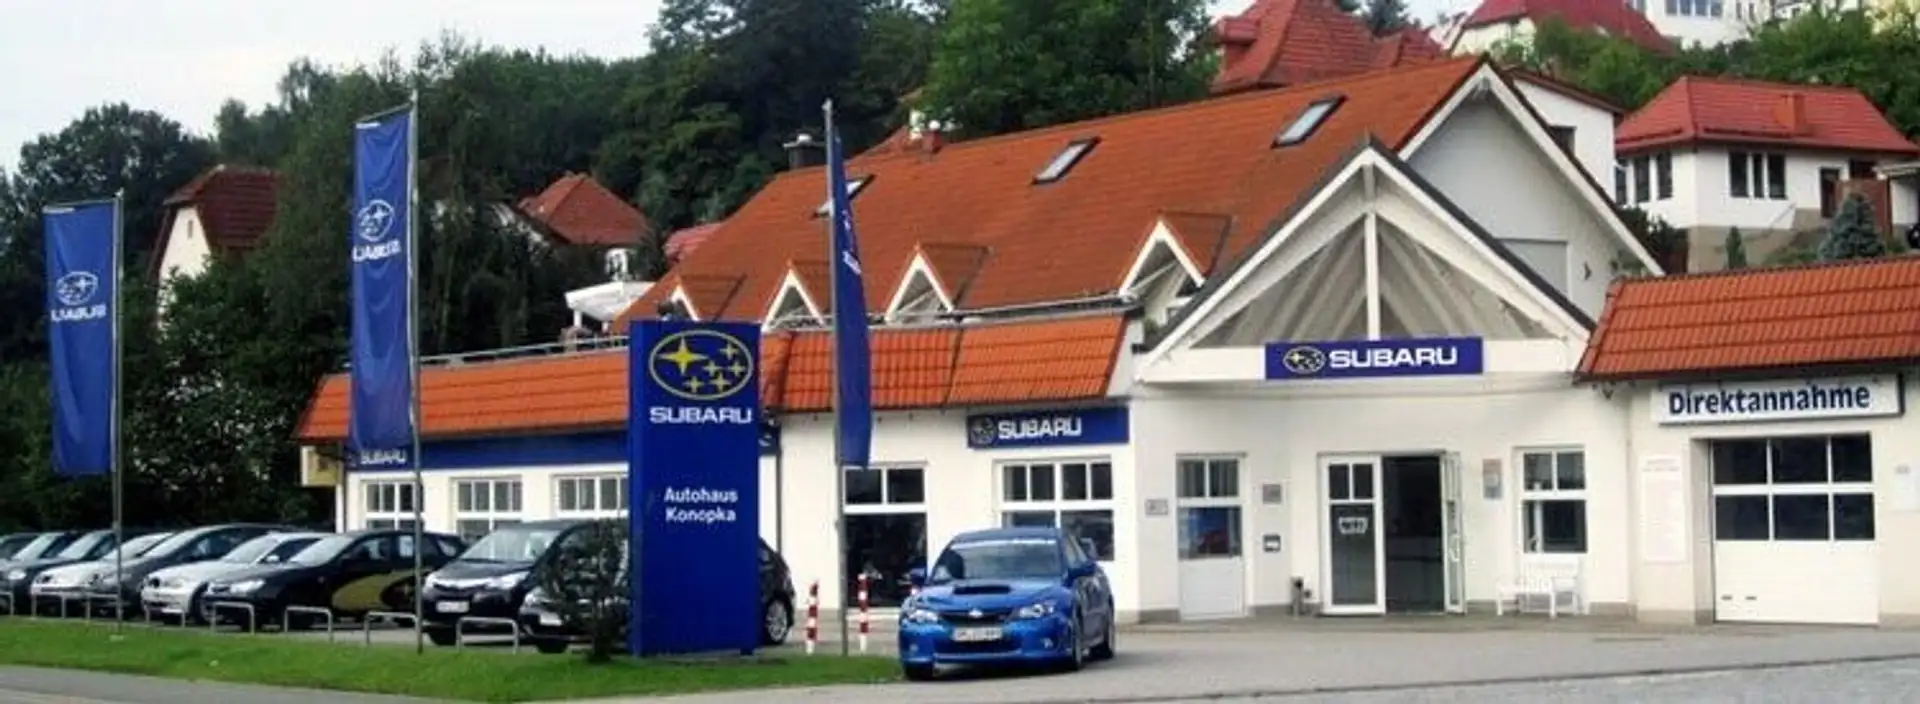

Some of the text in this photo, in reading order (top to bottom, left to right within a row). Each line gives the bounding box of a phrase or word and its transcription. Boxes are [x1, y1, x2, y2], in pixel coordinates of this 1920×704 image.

[1329, 347, 1458, 368] SUBARU
[1669, 385, 1871, 415] Direktannahme
[649, 406, 752, 424] SUBARU
[997, 417, 1082, 439] SUBARU
[664, 485, 738, 503] Autohaus
[665, 505, 737, 524] Konopka
